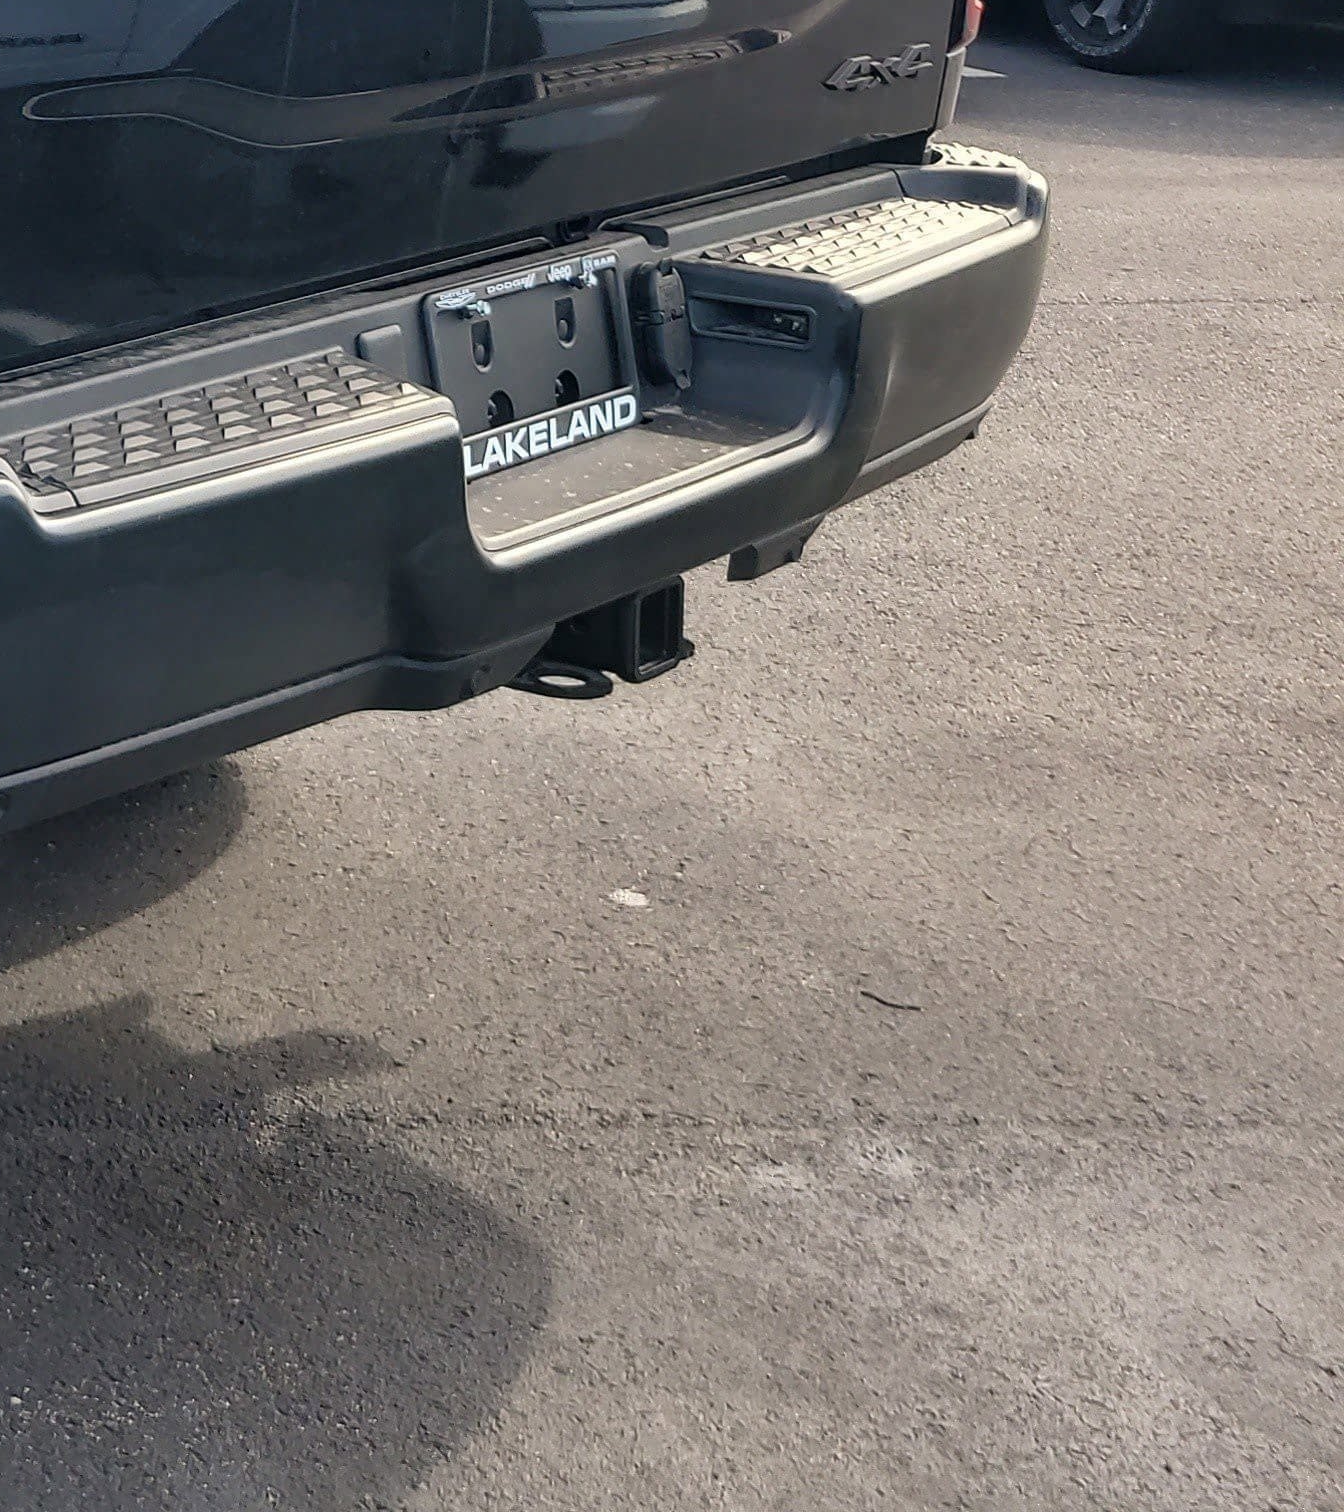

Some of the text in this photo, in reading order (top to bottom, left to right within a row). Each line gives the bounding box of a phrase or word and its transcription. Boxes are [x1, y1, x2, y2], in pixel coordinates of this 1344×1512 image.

[486, 276, 529, 294] DODGE
[546, 263, 572, 282] Jeep
[462, 393, 638, 478] LAKELAND
